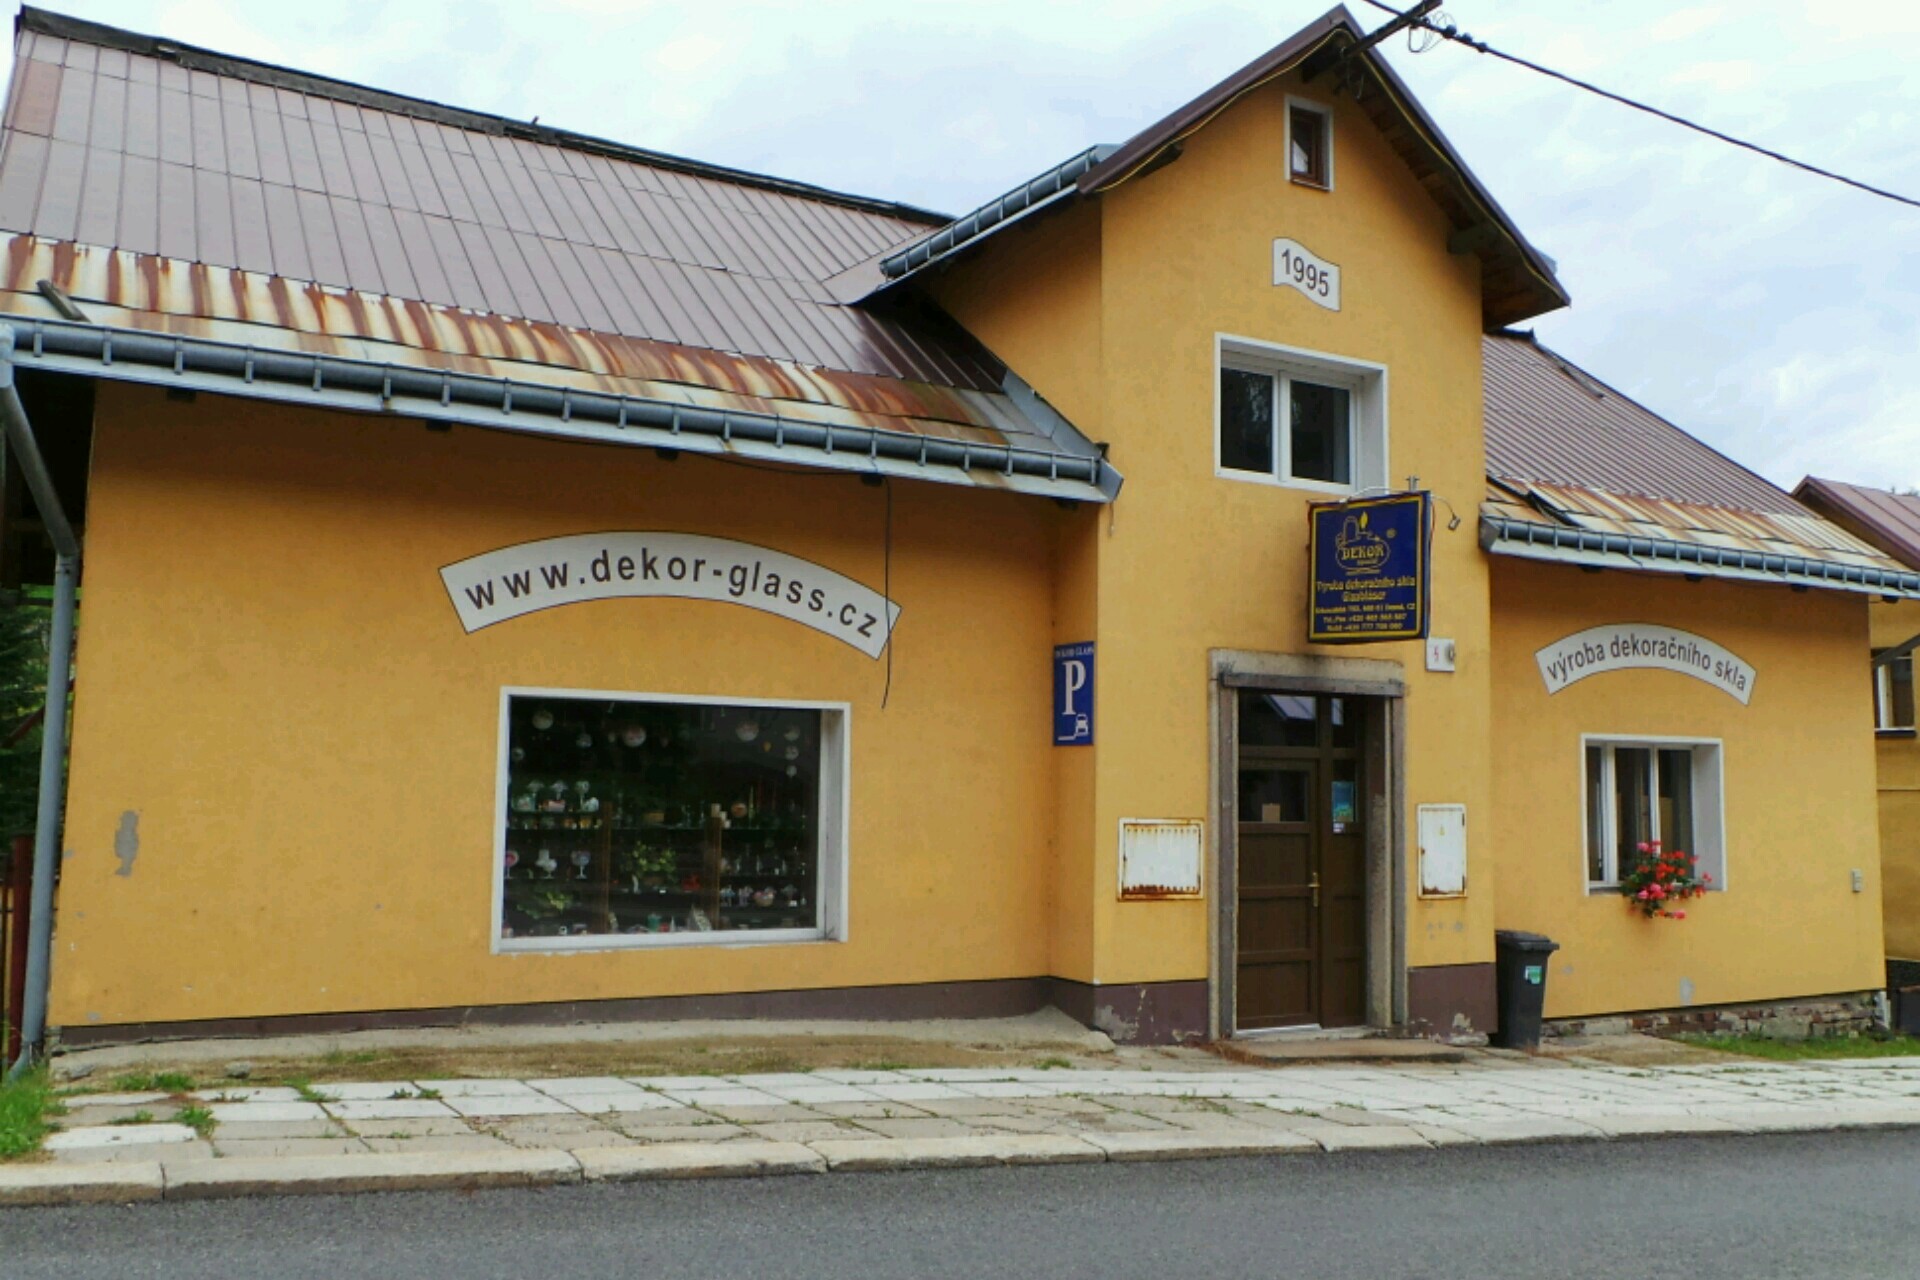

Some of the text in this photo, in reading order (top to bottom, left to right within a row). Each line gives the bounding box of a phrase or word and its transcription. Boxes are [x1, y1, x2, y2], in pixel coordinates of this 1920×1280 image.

[1281, 248, 1329, 297] 1995
[465, 547, 877, 638] www.dekor-glass.cz
[1062, 660, 1087, 715] P
[1546, 633, 1747, 692] výroba dekoračního skla
